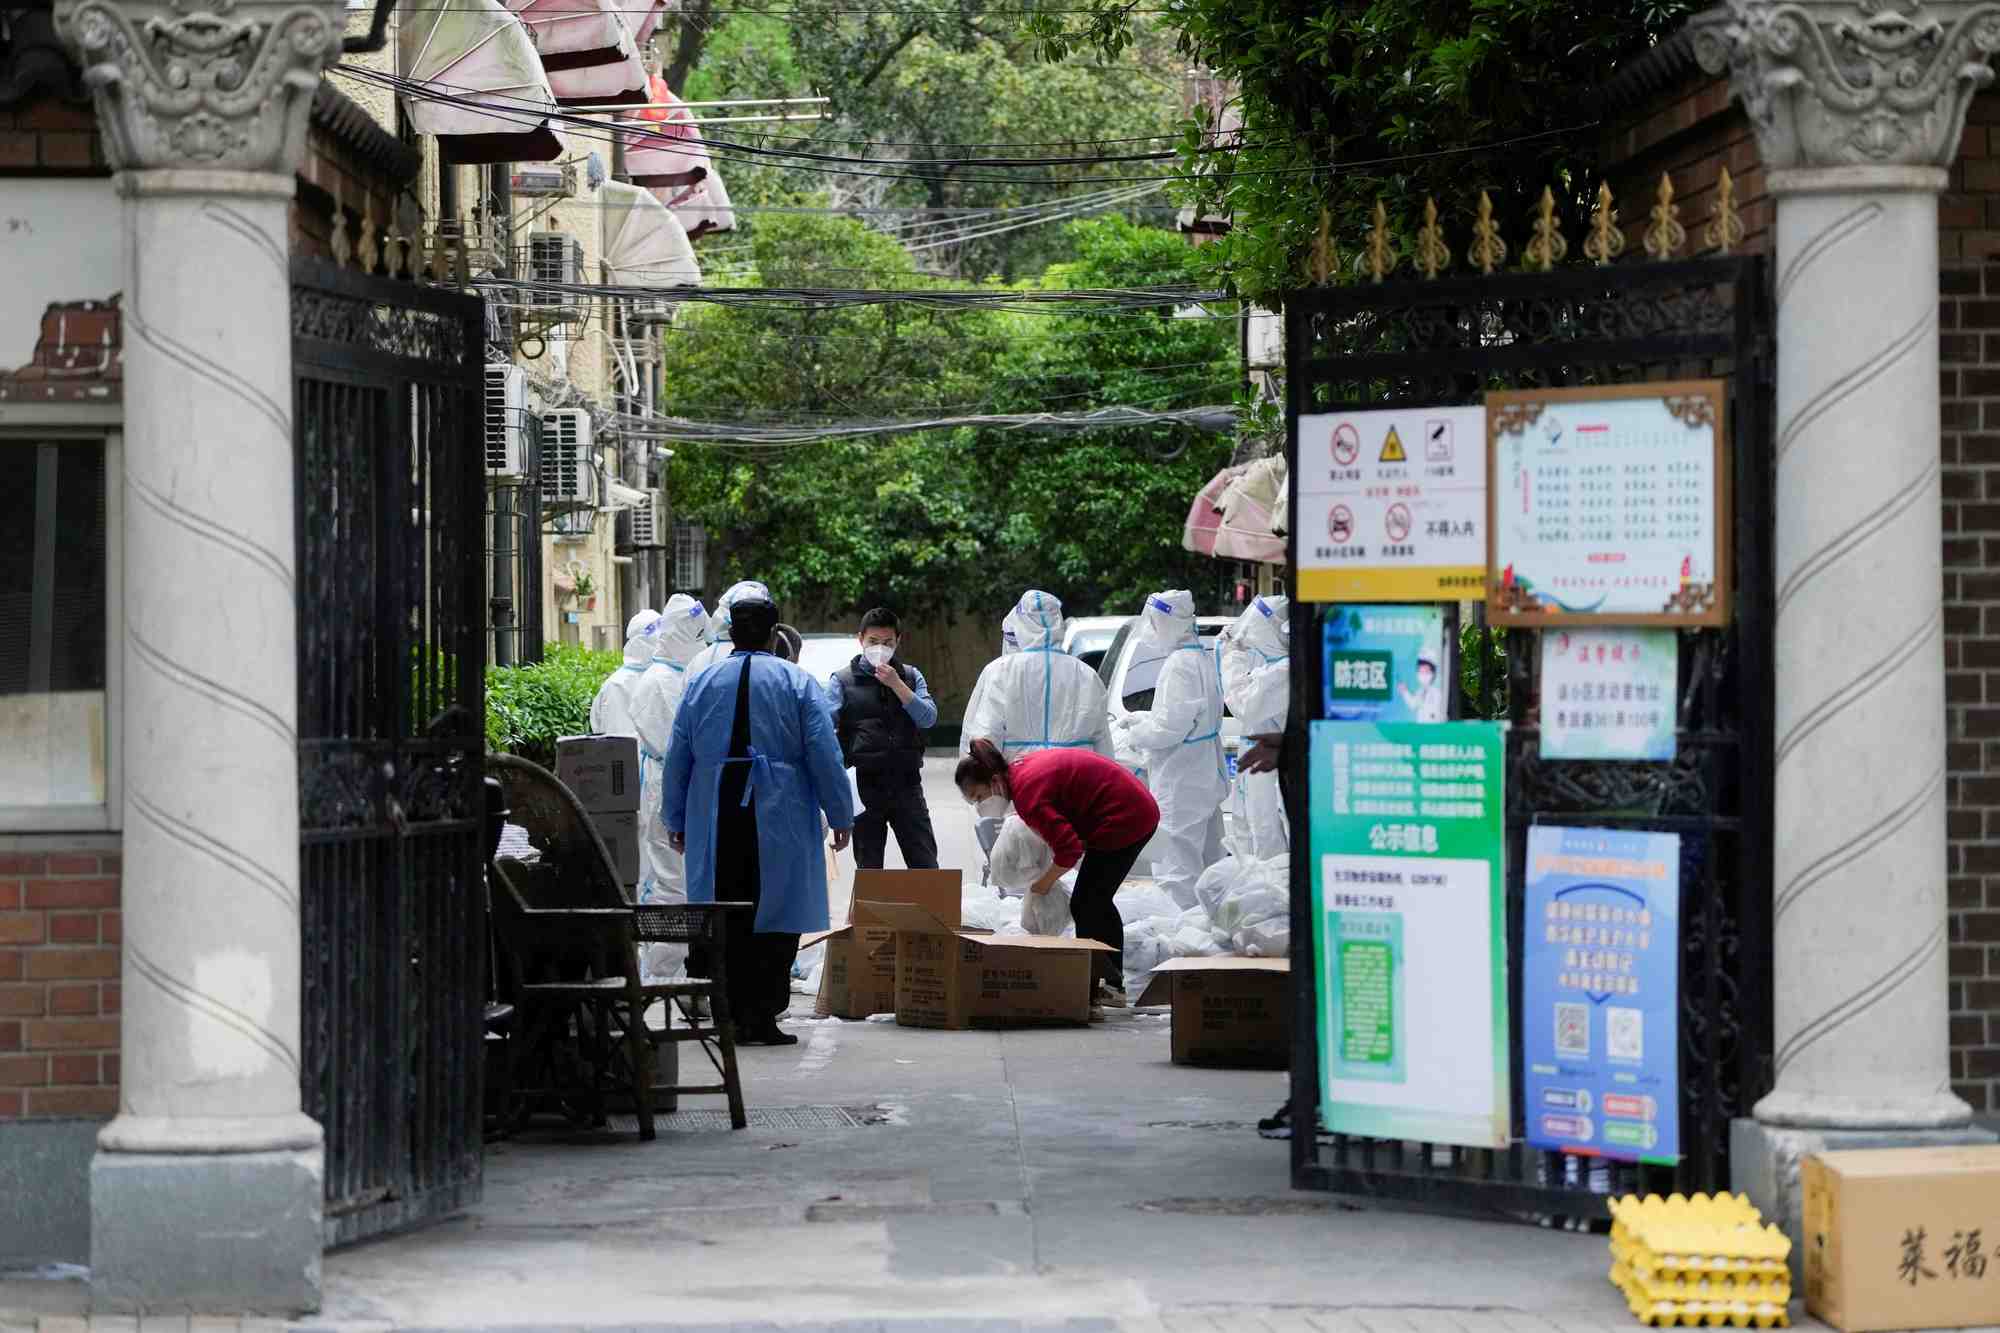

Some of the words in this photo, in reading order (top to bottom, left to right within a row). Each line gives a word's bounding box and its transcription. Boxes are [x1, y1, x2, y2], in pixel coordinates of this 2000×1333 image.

[1334, 660, 1387, 689] 防范区
[1368, 823, 1439, 853] 公示信息
